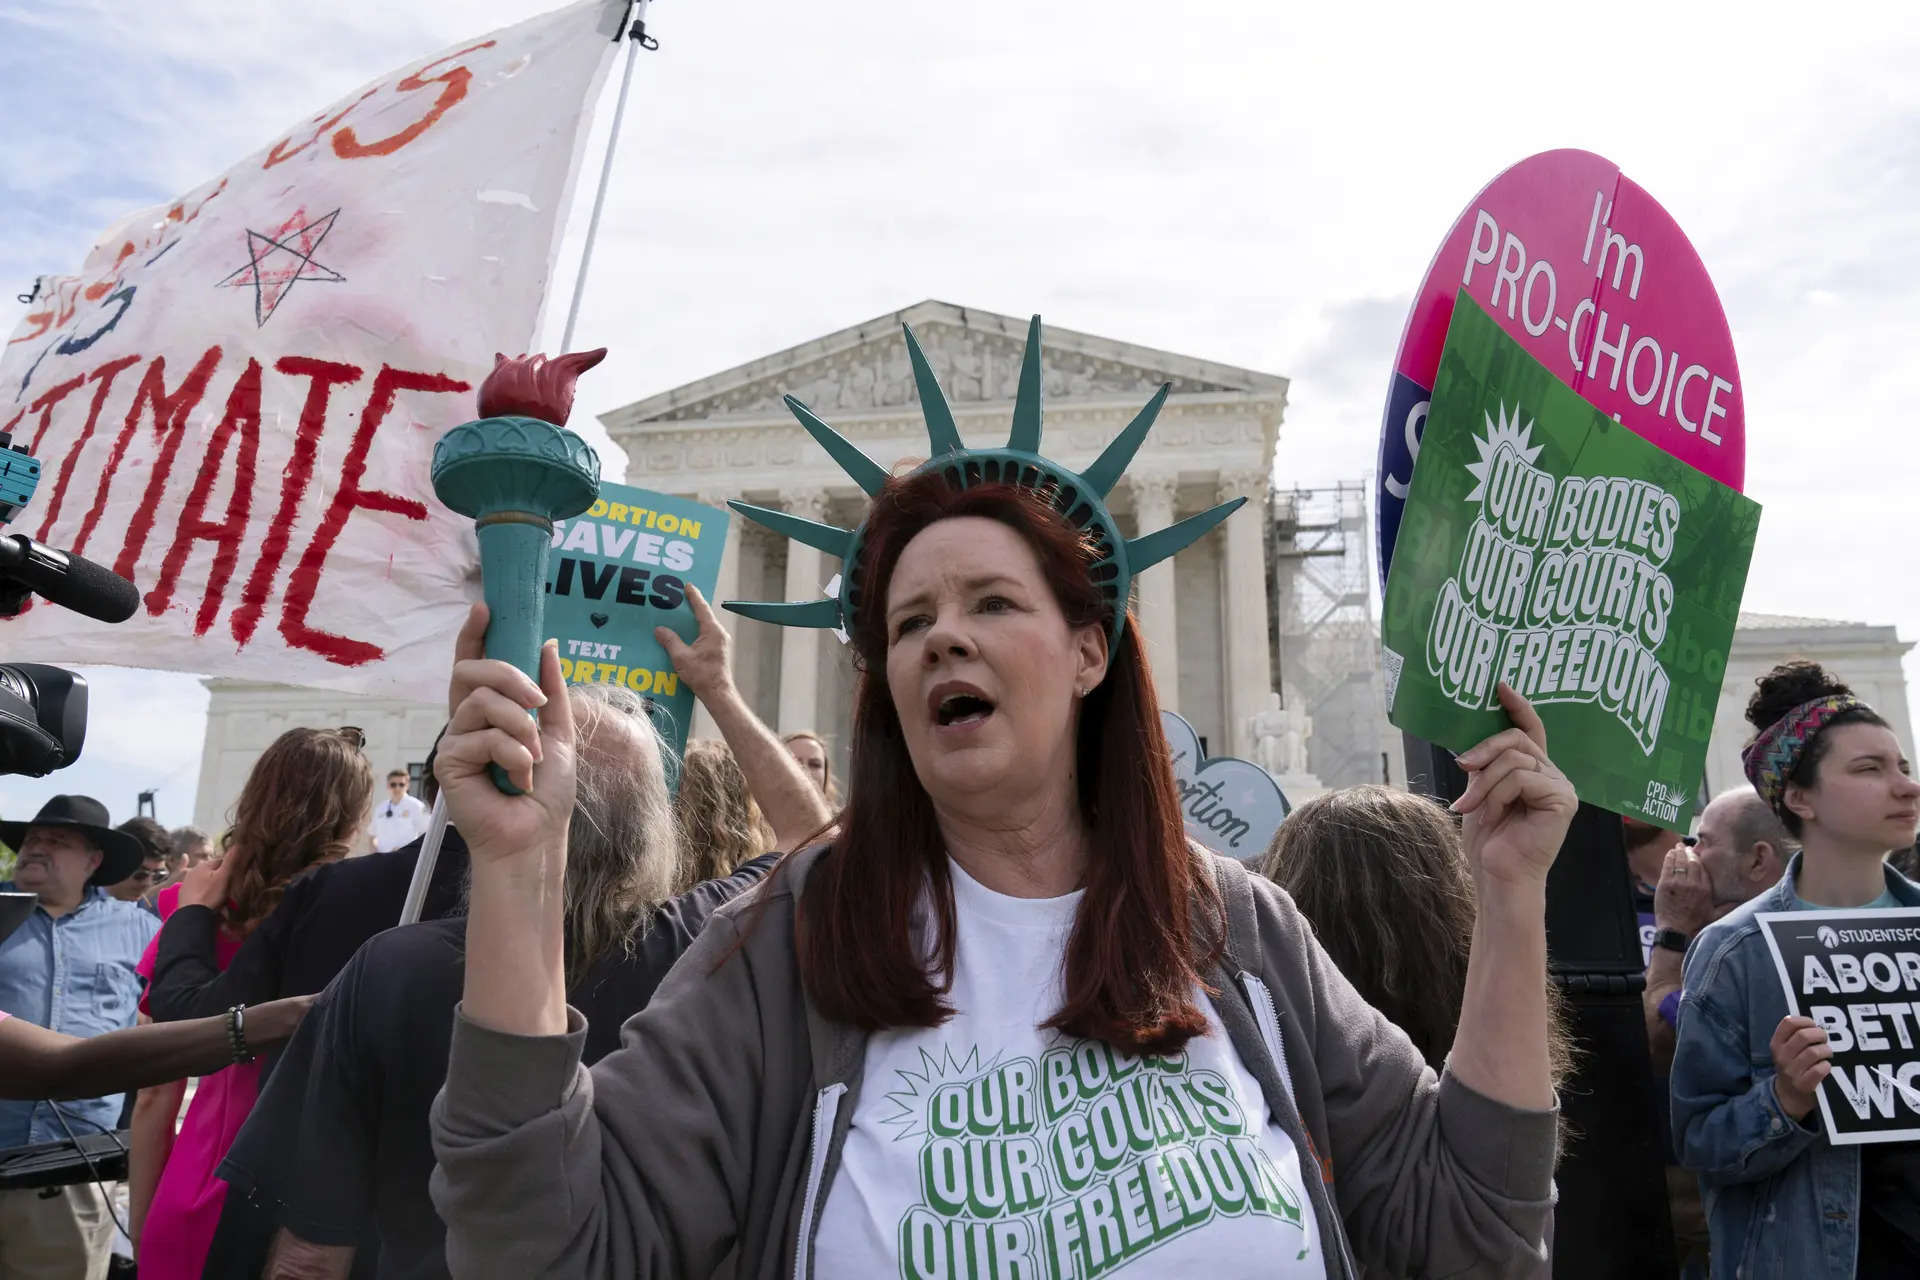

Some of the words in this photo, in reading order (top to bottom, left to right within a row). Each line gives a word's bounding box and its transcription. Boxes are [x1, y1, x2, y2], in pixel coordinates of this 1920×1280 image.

[1582, 190, 1645, 300] I'm
[1462, 208, 1734, 447] PRO-CHOICE
[1486, 443, 1554, 546] OUR
[1547, 478, 1679, 565] BODIES
[549, 519, 694, 572] SAVES
[546, 557, 687, 610] IVES
[1461, 519, 1533, 623] OUR
[1528, 551, 1674, 646] COURTS
[567, 639, 621, 660] TEXT
[1430, 578, 1498, 704] OUR
[1493, 627, 1670, 750] FREEDOM
[1642, 801, 1679, 823] ACTION
[1646, 780, 1667, 800] CPD
[1803, 952, 1920, 994] ABOR
[1809, 1002, 1920, 1052] BET
[931, 1061, 1035, 1136] OUR
[923, 1138, 1047, 1218] OUR
[1053, 1073, 1242, 1191] COURTS
[903, 1209, 1031, 1280] OUR
